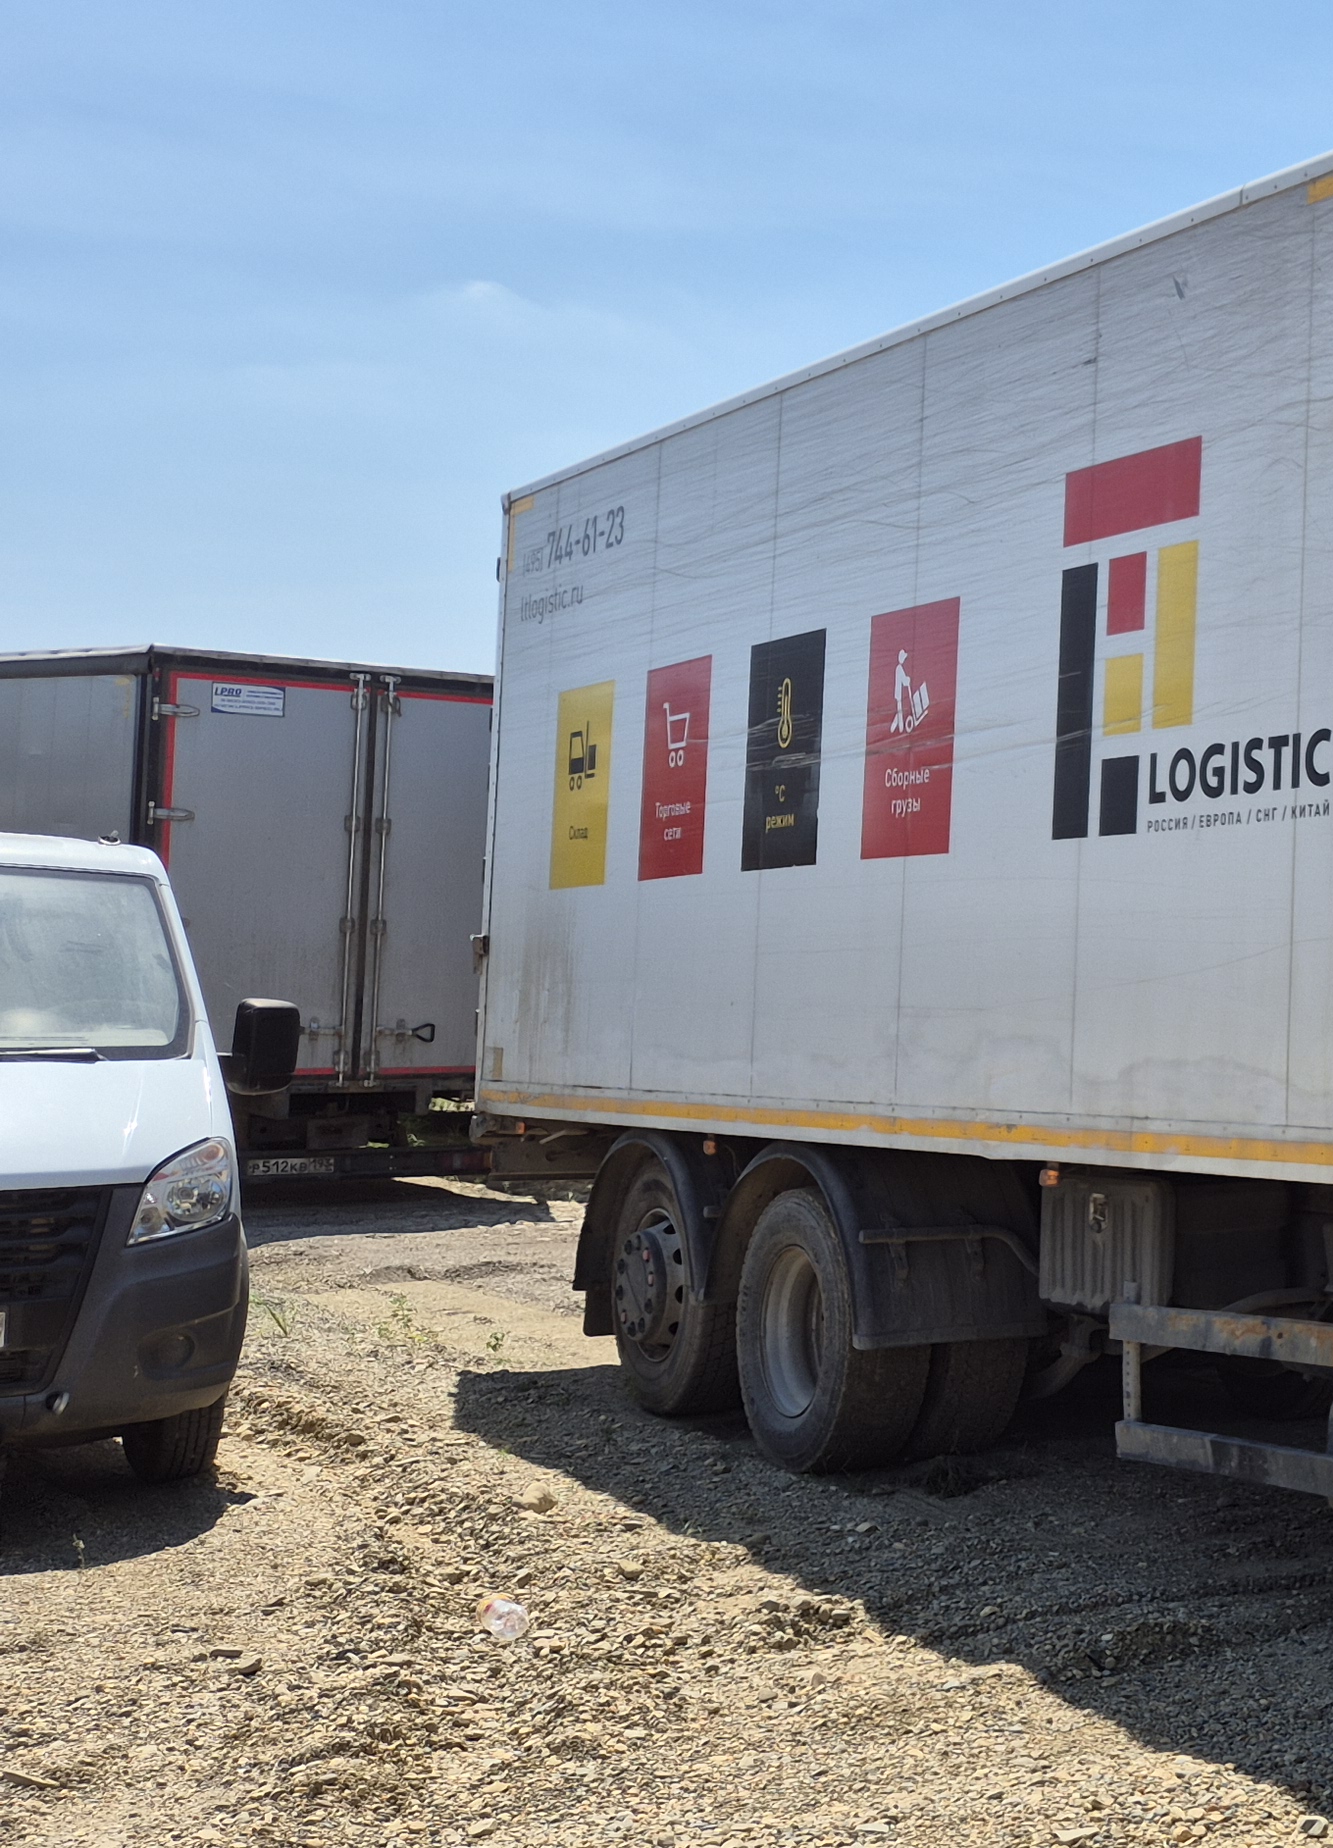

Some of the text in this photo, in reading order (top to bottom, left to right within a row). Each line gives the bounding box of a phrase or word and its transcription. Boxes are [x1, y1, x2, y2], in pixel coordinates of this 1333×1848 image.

[547, 505, 625, 569] 744-61-23
[214, 686, 242, 697] LPRO
[1148, 728, 1332, 804] LOGISTIC
[885, 768, 931, 790] Сборные
[655, 801, 691, 821] Торговые
[891, 797, 921, 818] грузы
[1147, 819, 1188, 833] РОССИЯ
[1199, 811, 1242, 829] ЕВРОПА
[1256, 807, 1278, 823] СНГ
[1291, 799, 1330, 820] КИТАЙ
[765, 813, 795, 833] режим
[568, 826, 589, 841] Склад
[664, 827, 681, 841] сети
